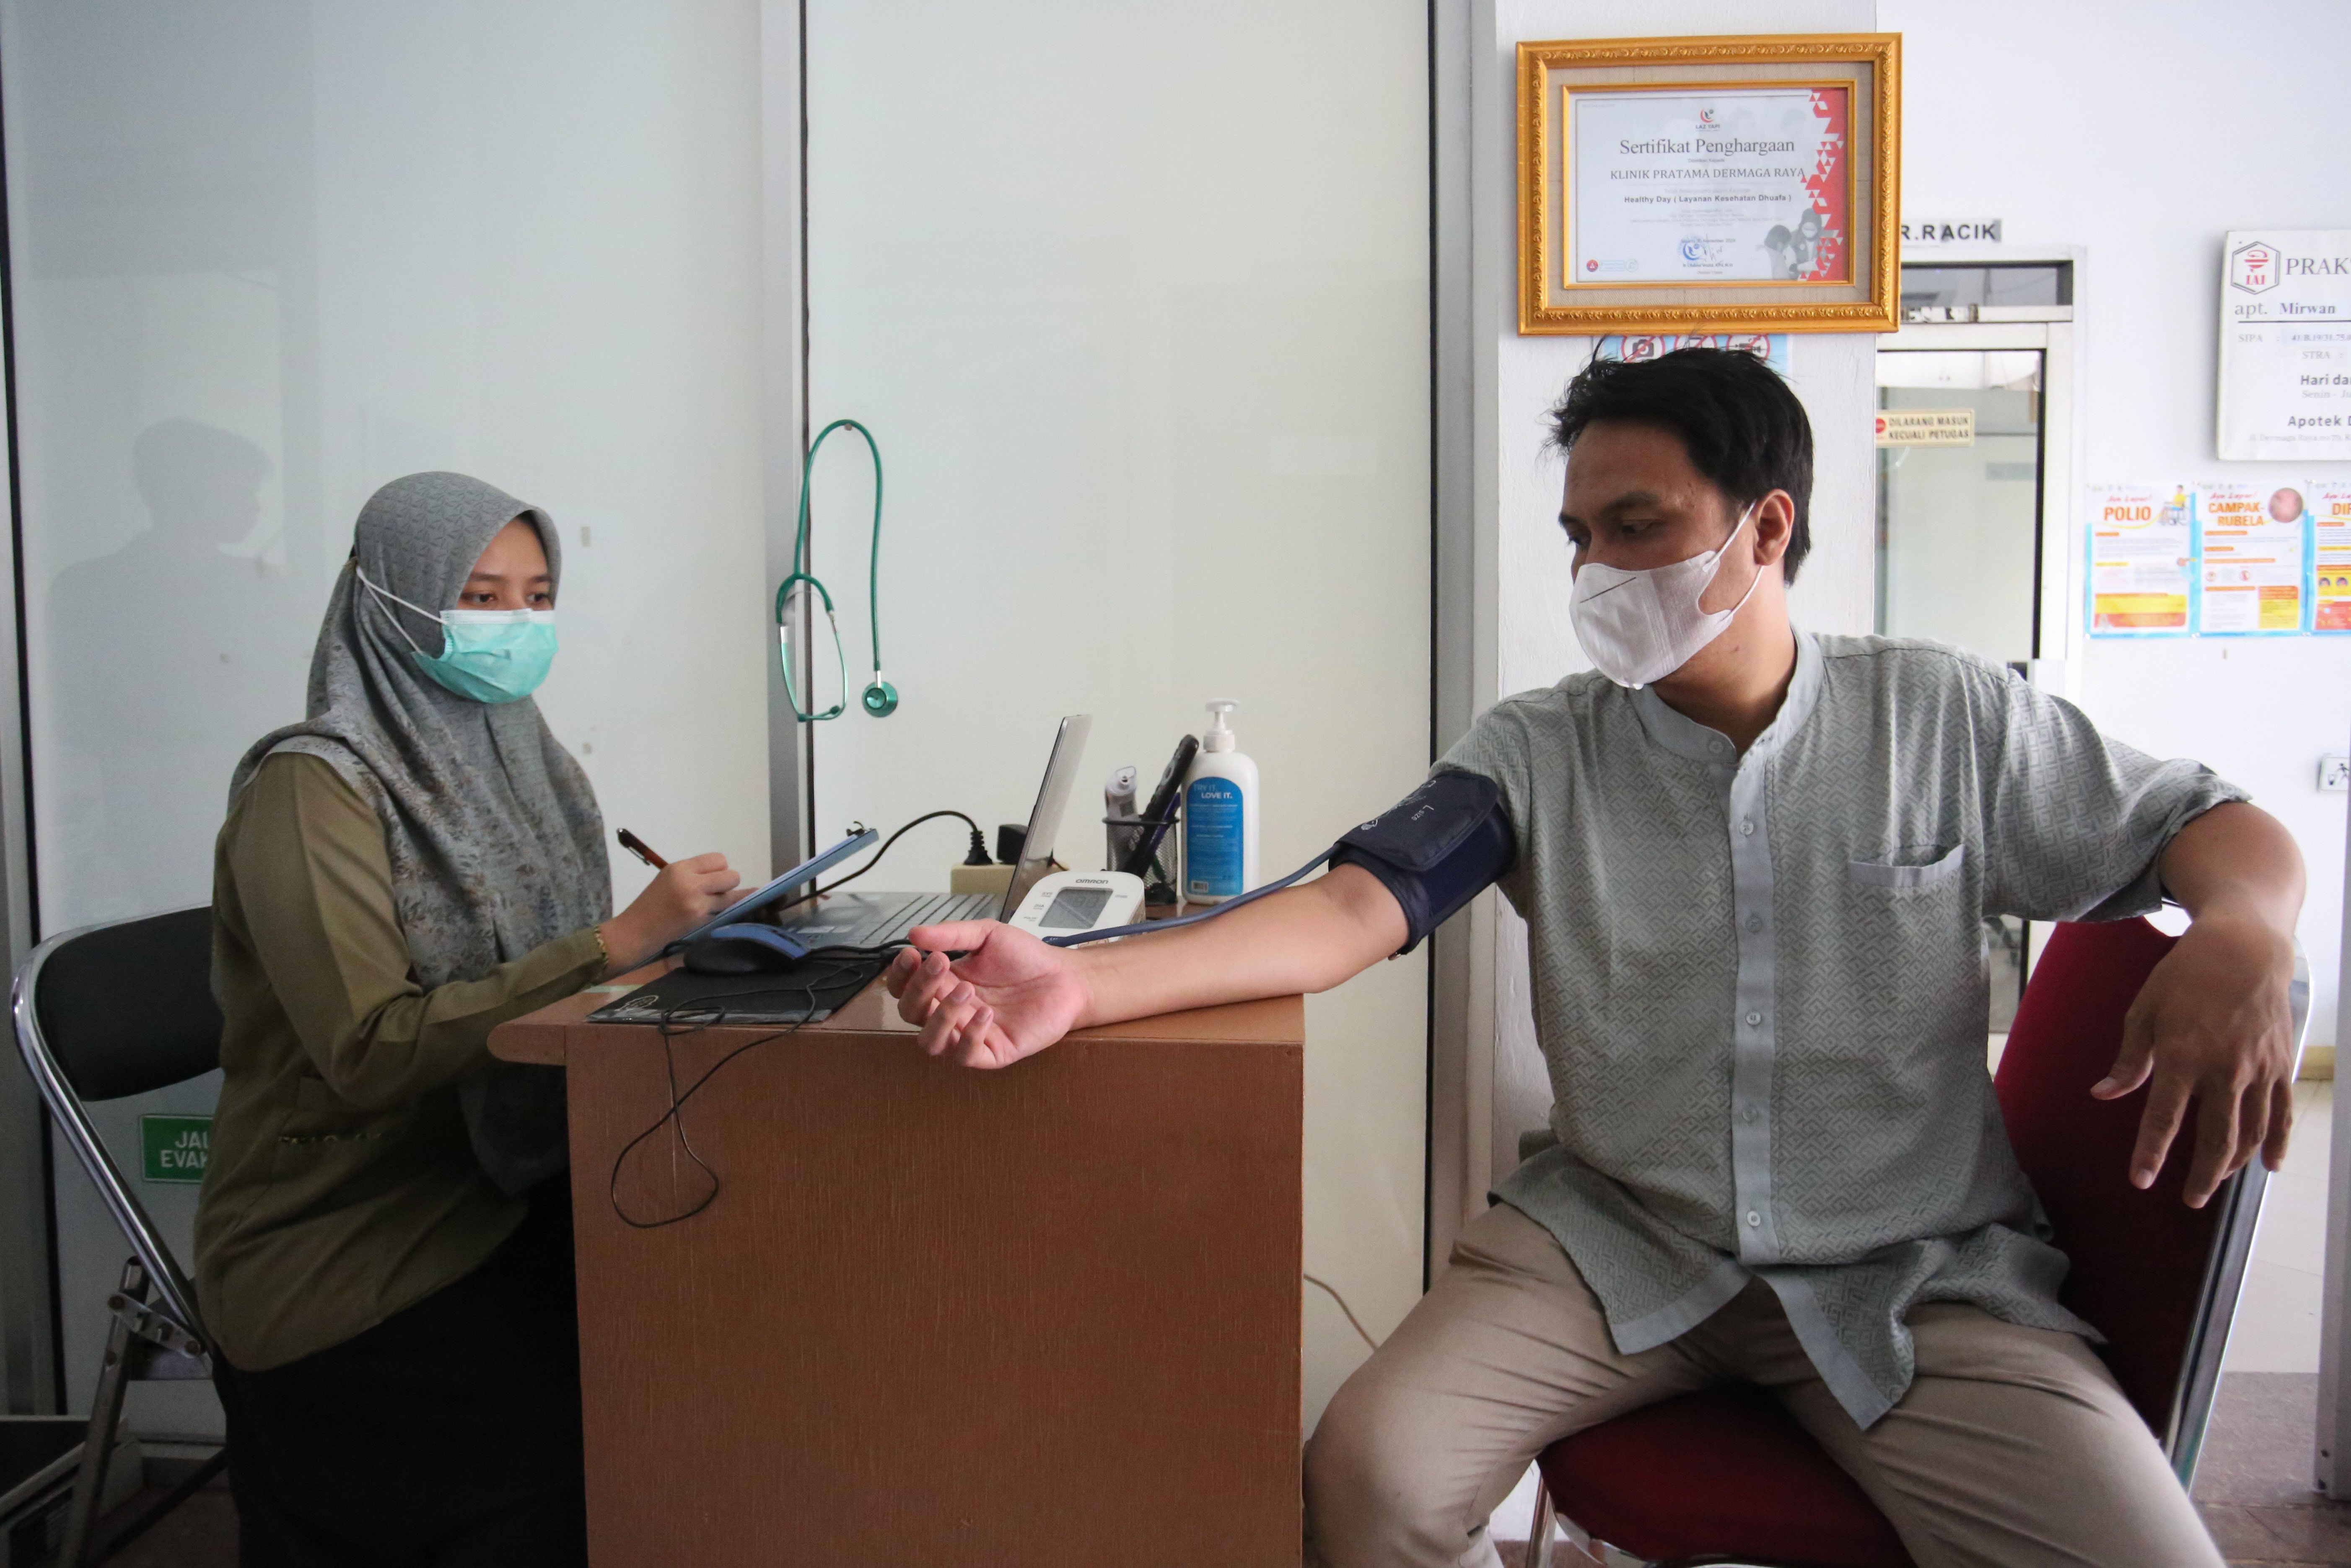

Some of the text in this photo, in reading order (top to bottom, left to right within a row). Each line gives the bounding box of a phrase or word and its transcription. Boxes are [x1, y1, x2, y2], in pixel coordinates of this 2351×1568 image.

[1620, 138, 1794, 156] Sertifikat Penghargaan
[1611, 168, 1805, 179] KLINIK PRATAMA DERMAGA RAYA
[2285, 257, 2351, 275] PRAK
[2246, 275, 2265, 285] IAI
[2234, 302, 2336, 319] apt. Mirwan
[2300, 374, 2329, 385] Hari
[1888, 417, 1934, 426] DILARANG
[1937, 415, 1968, 426] MASUK
[2287, 415, 2342, 429] Apotek
[1888, 430, 1926, 440] KECUALI
[1928, 430, 1969, 439] PETUGAS
[2104, 505, 2151, 521] POLIO
[2208, 502, 2264, 513] CAMPAK-
[2218, 516, 2264, 526] RUBELA
